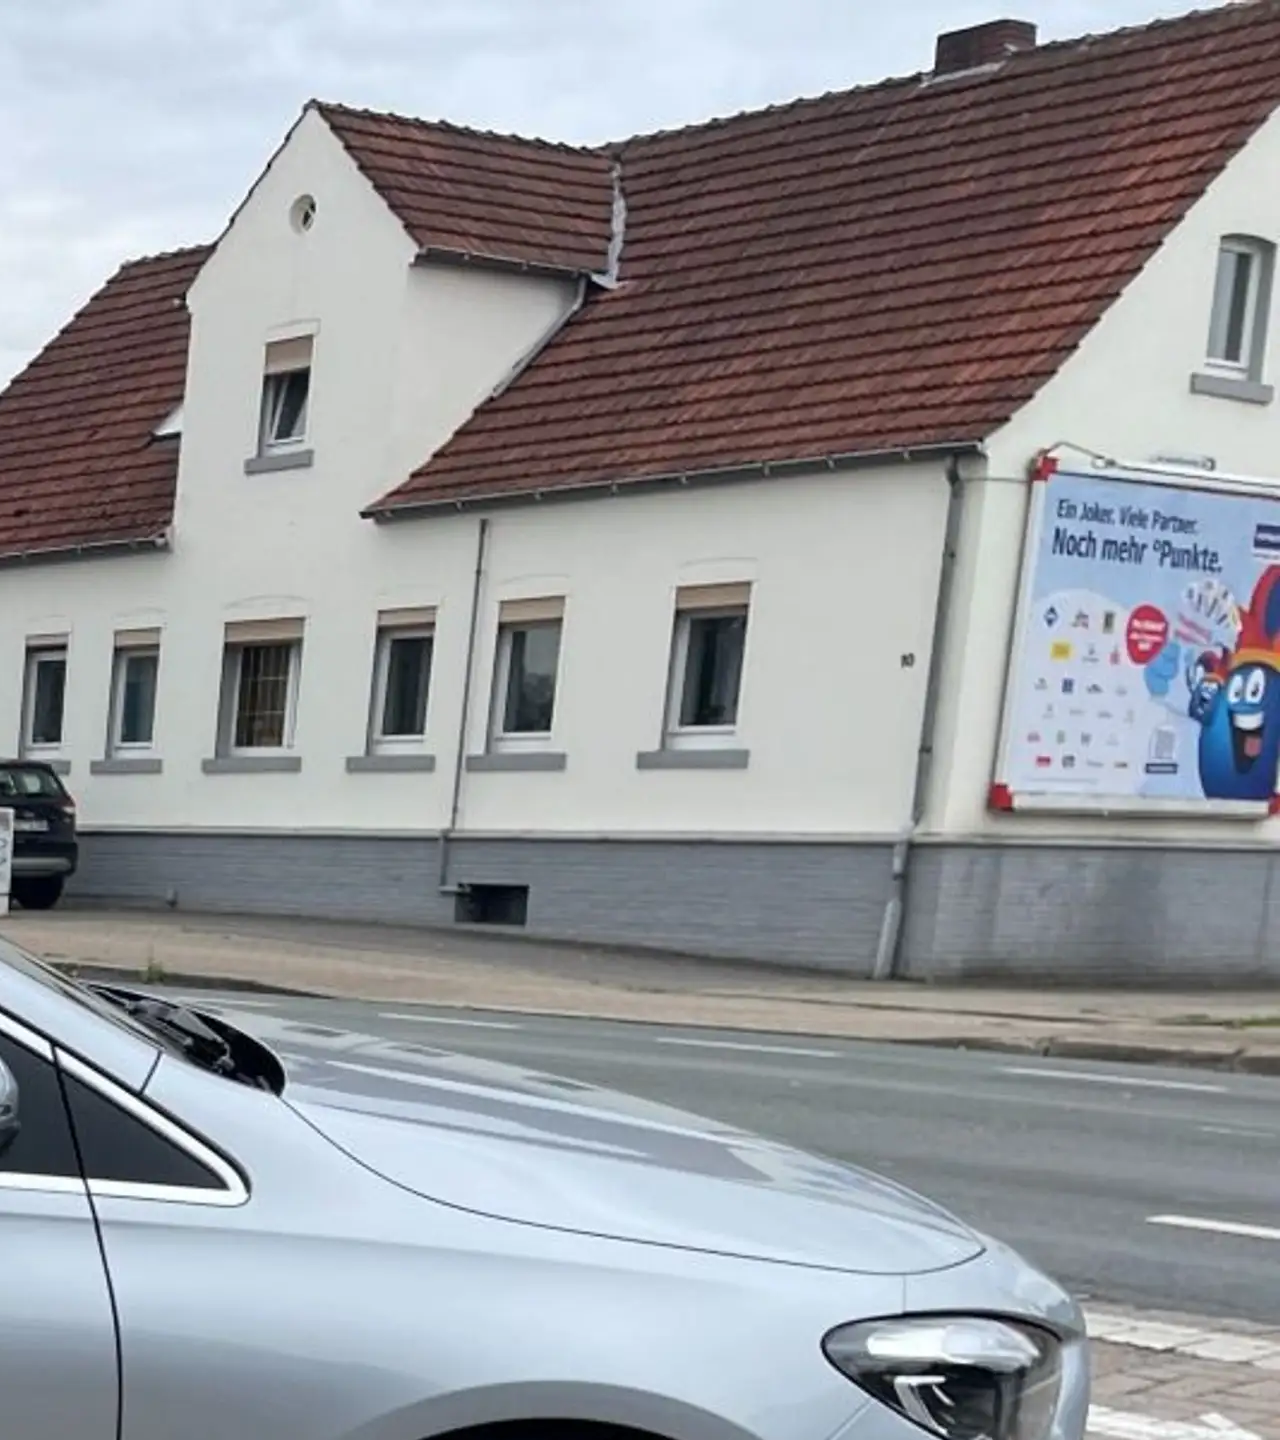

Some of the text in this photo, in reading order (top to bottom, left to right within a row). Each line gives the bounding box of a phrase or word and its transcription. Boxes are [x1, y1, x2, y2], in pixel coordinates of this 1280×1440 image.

[1057, 499, 1077, 519] Ein
[1119, 505, 1149, 530] Viele
[1052, 526, 1097, 561] Noch
[1101, 533, 1148, 565] mehr
